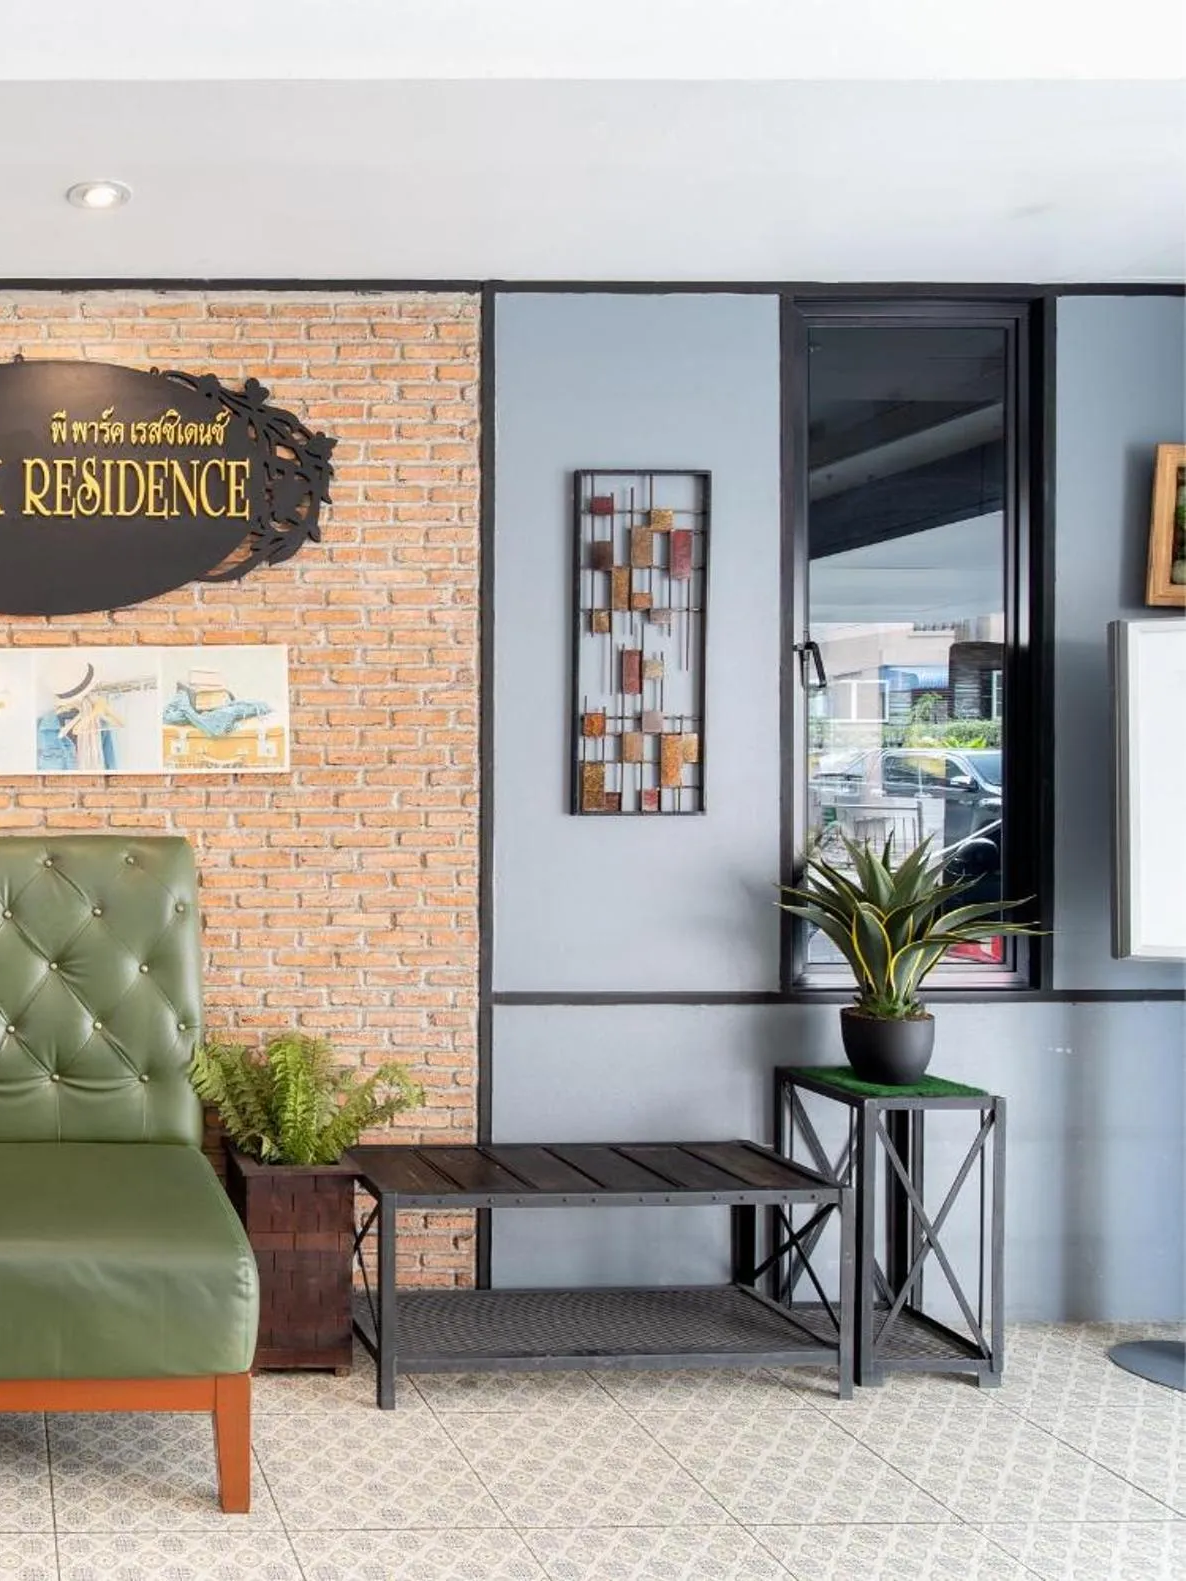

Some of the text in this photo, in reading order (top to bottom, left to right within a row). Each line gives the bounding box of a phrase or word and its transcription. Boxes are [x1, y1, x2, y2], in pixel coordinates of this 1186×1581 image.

[51, 410, 67, 444] พี
[72, 406, 124, 444] พาร์ค
[22, 456, 250, 519] RESIDENCE
